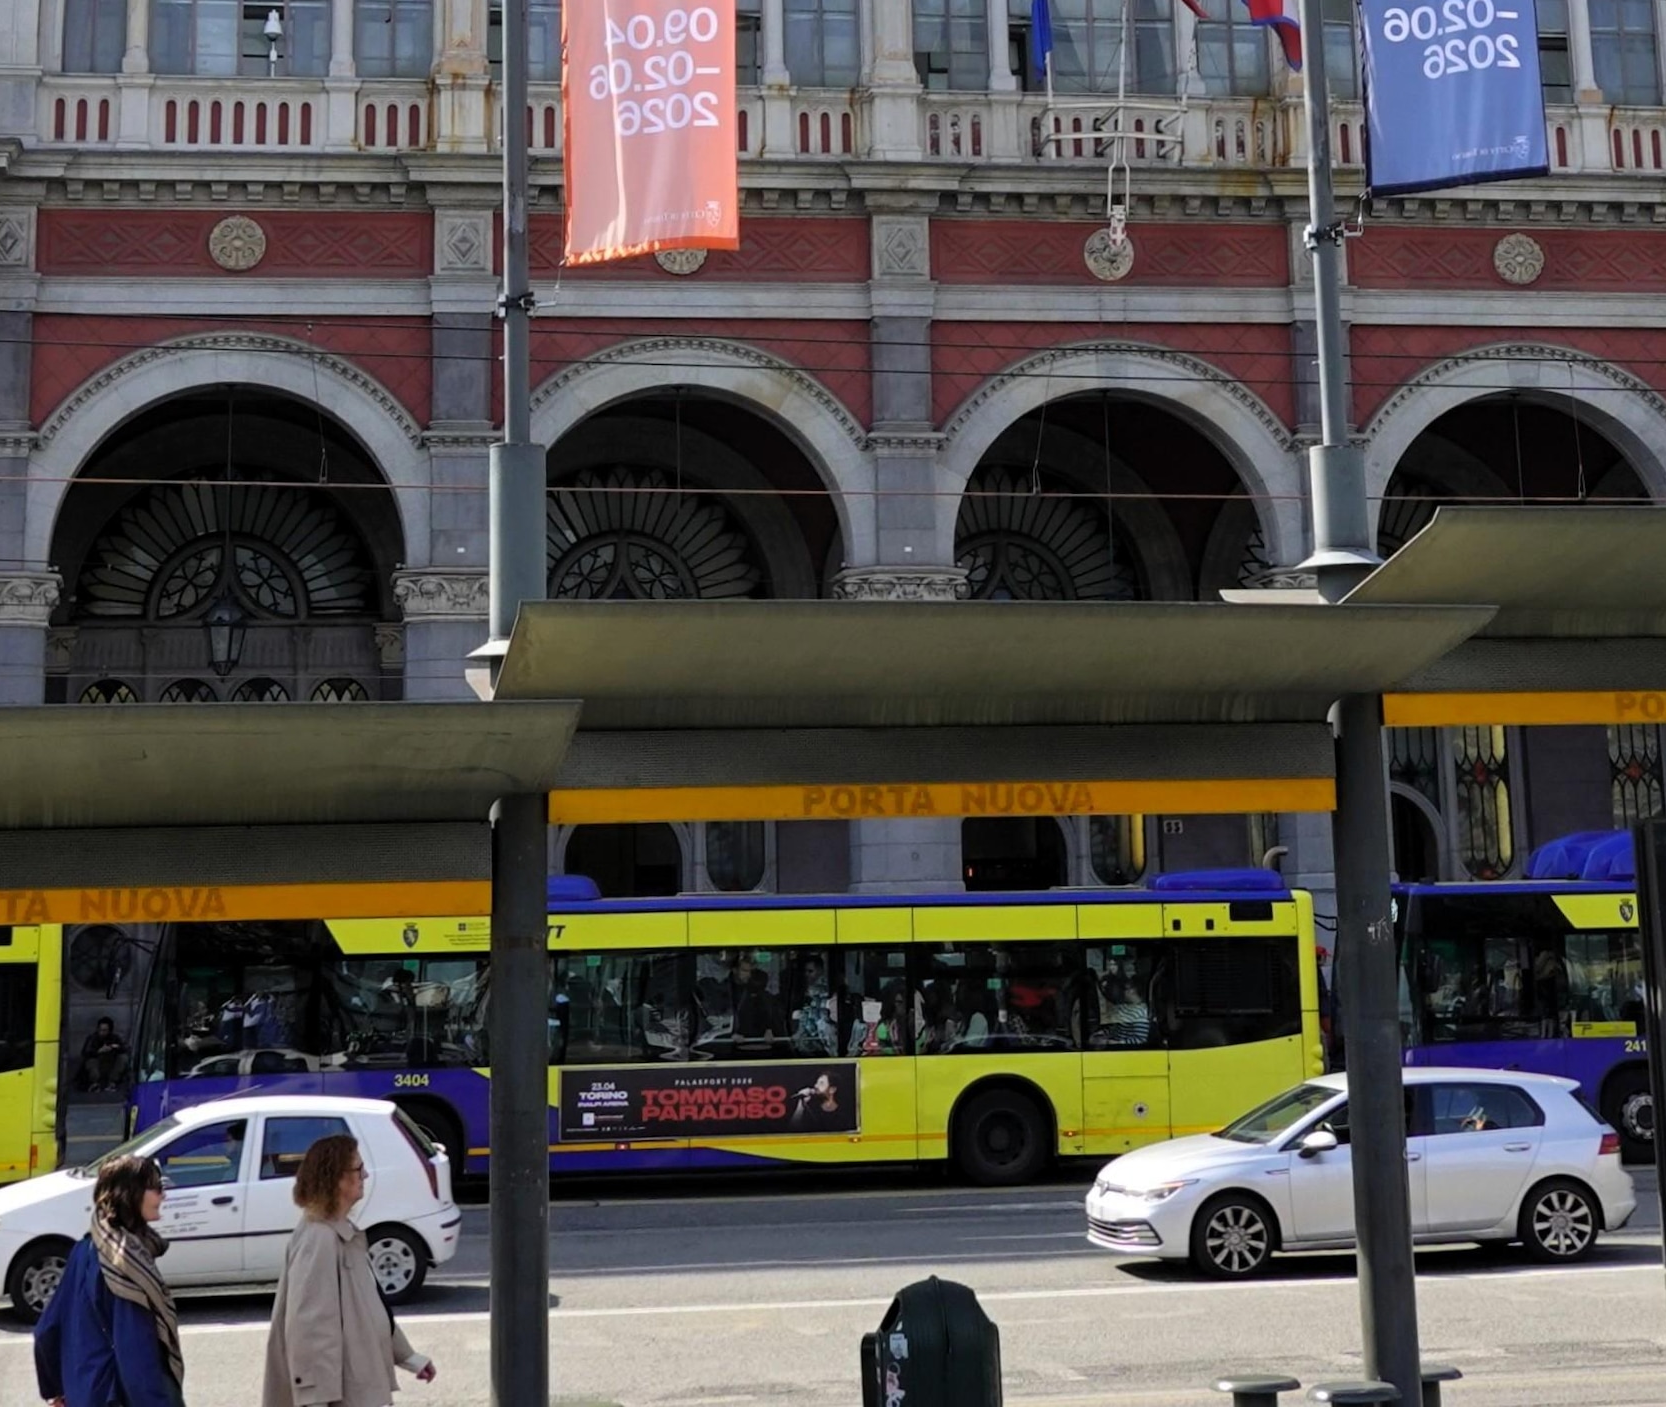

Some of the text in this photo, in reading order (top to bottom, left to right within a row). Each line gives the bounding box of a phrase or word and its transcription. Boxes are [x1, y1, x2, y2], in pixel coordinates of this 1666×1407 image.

[802, 783, 1094, 816] PORTA NUOVA
[80, 887, 227, 920] NUOVA
[547, 925, 565, 939] TT
[1625, 1040, 1647, 1052] 241
[394, 1074, 430, 1087] 3404
[579, 1091, 628, 1100] TORINO
[641, 1086, 787, 1106] TOMMASO
[641, 1103, 787, 1122] PARADISO
